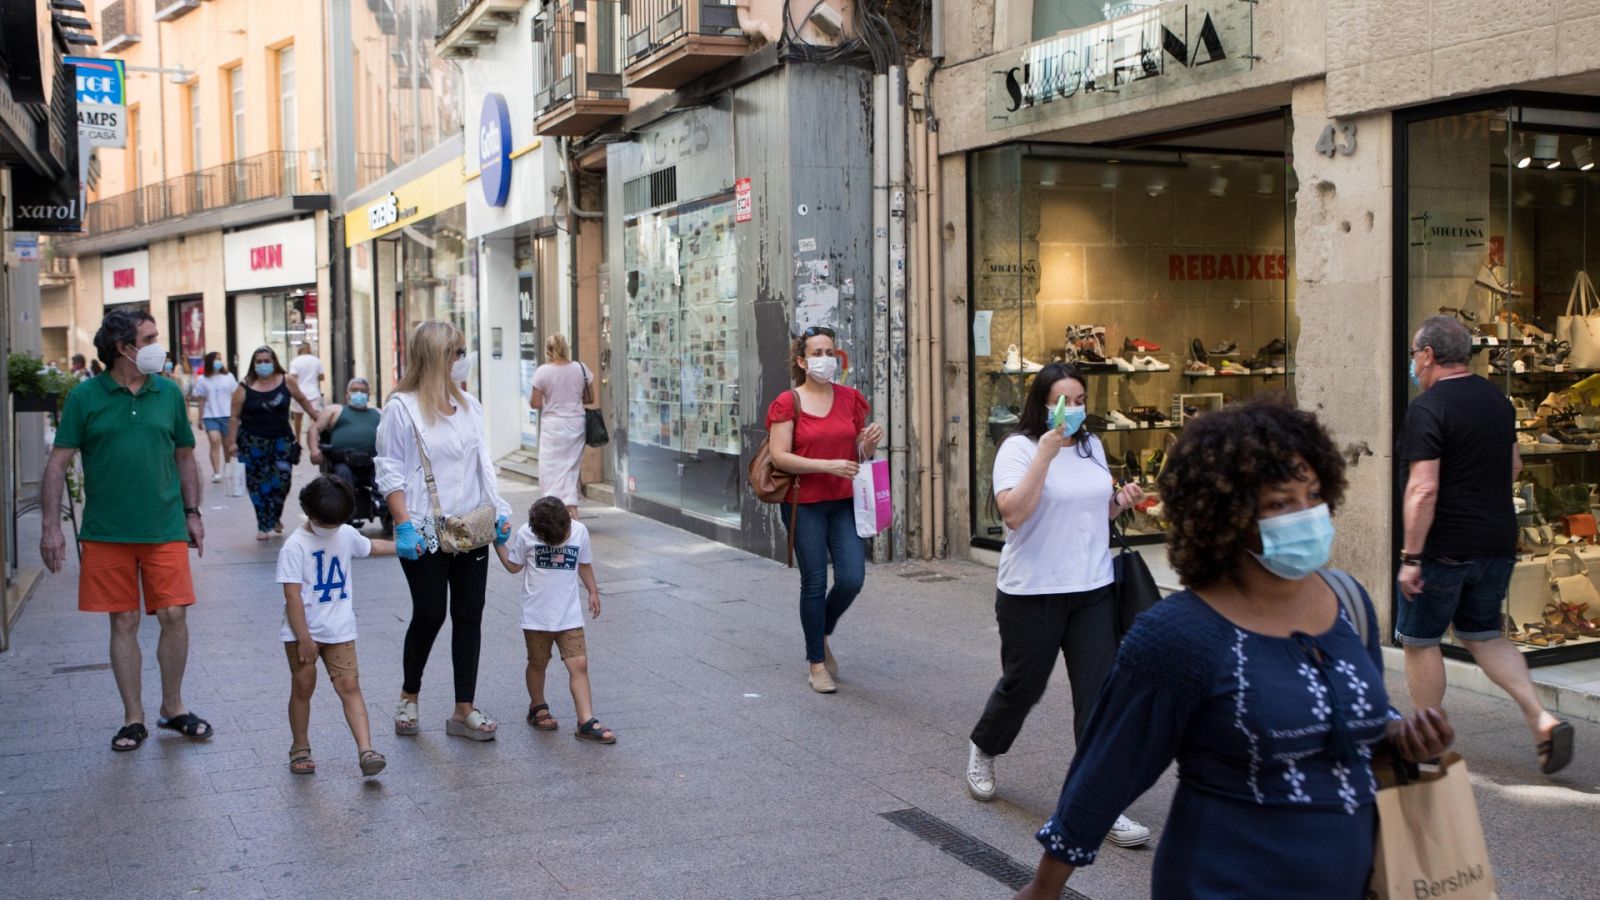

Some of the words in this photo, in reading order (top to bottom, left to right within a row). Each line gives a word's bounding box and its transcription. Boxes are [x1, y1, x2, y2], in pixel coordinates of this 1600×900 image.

[1006, 4, 1226, 113] SITGEANA
[1314, 121, 1358, 159] 43
[17, 199, 77, 220] xarol
[1168, 253, 1291, 281] REBAIXES
[311, 549, 348, 604] LA
[1413, 864, 1484, 900] Bershka
